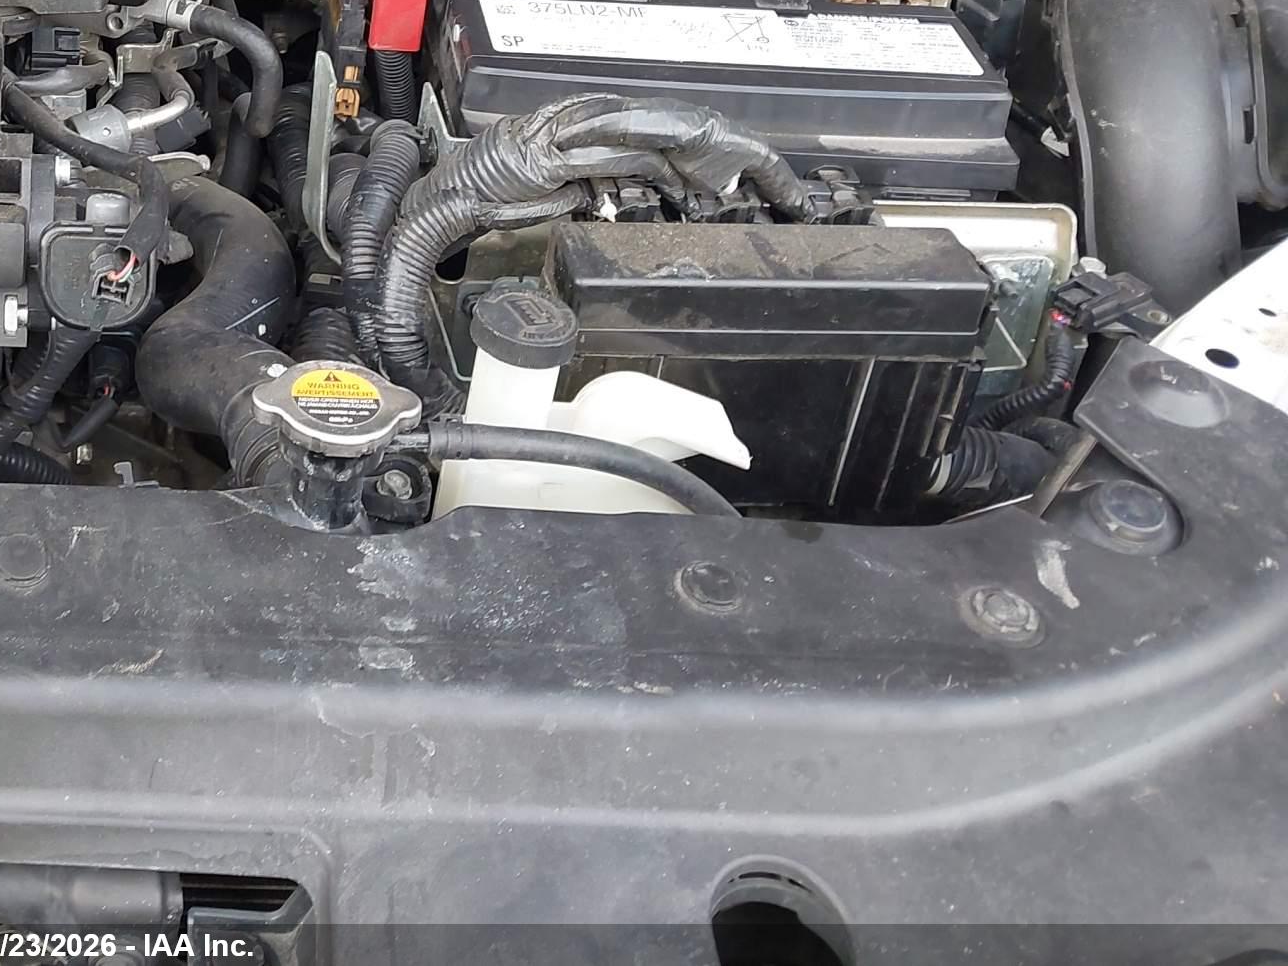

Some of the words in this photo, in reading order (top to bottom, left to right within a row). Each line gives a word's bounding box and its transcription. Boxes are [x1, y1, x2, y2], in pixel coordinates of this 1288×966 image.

[500, 35, 524, 48] SP
[307, 382, 360, 390] WARNING
[296, 389, 374, 397] AVERTISSEMENT
